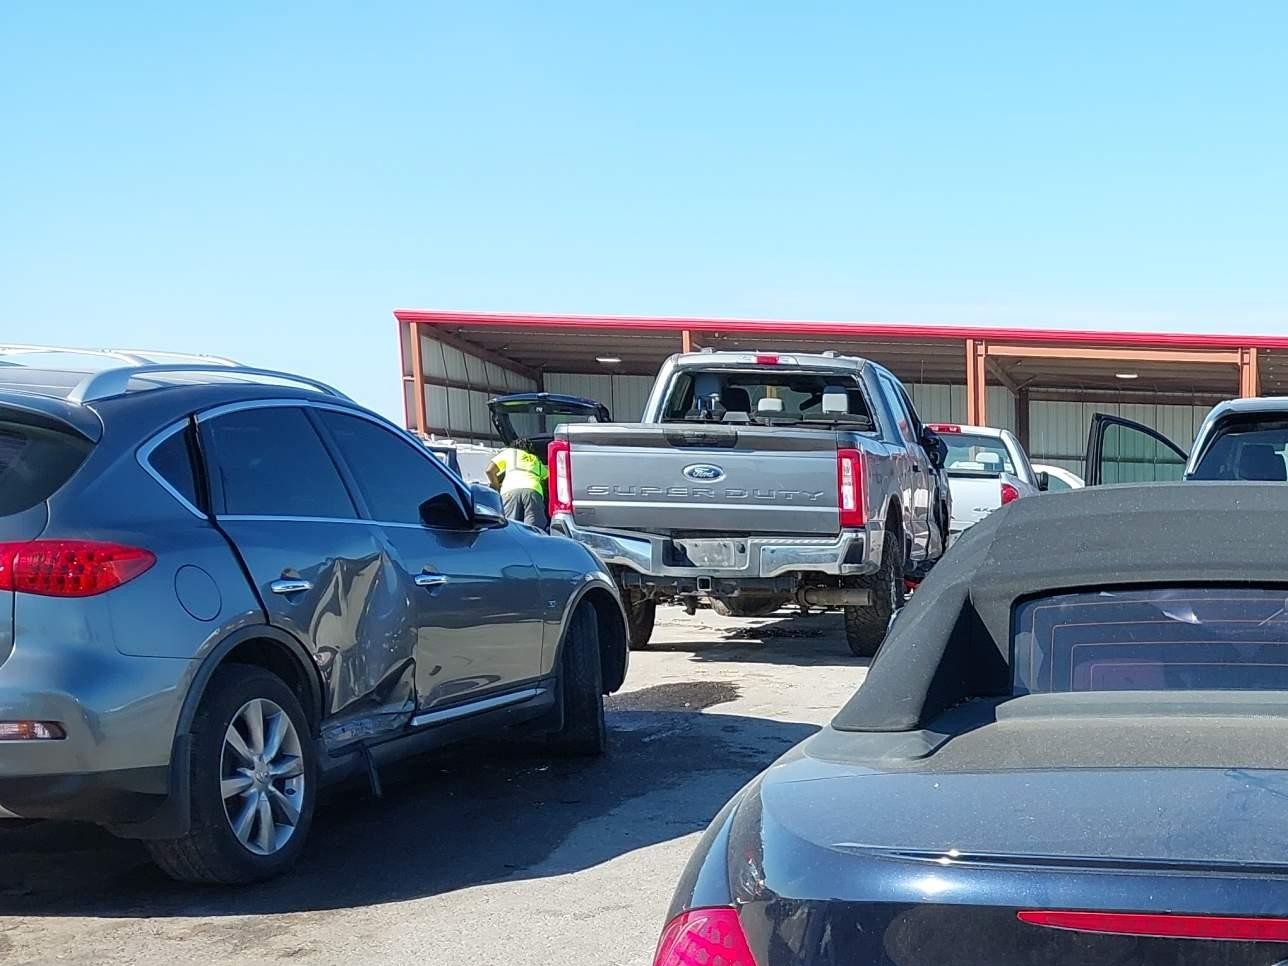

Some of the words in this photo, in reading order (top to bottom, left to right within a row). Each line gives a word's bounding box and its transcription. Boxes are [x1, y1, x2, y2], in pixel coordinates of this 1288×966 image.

[692, 466, 715, 478] Ford
[586, 485, 715, 498] SUPER
[724, 488, 824, 501] DUTY
